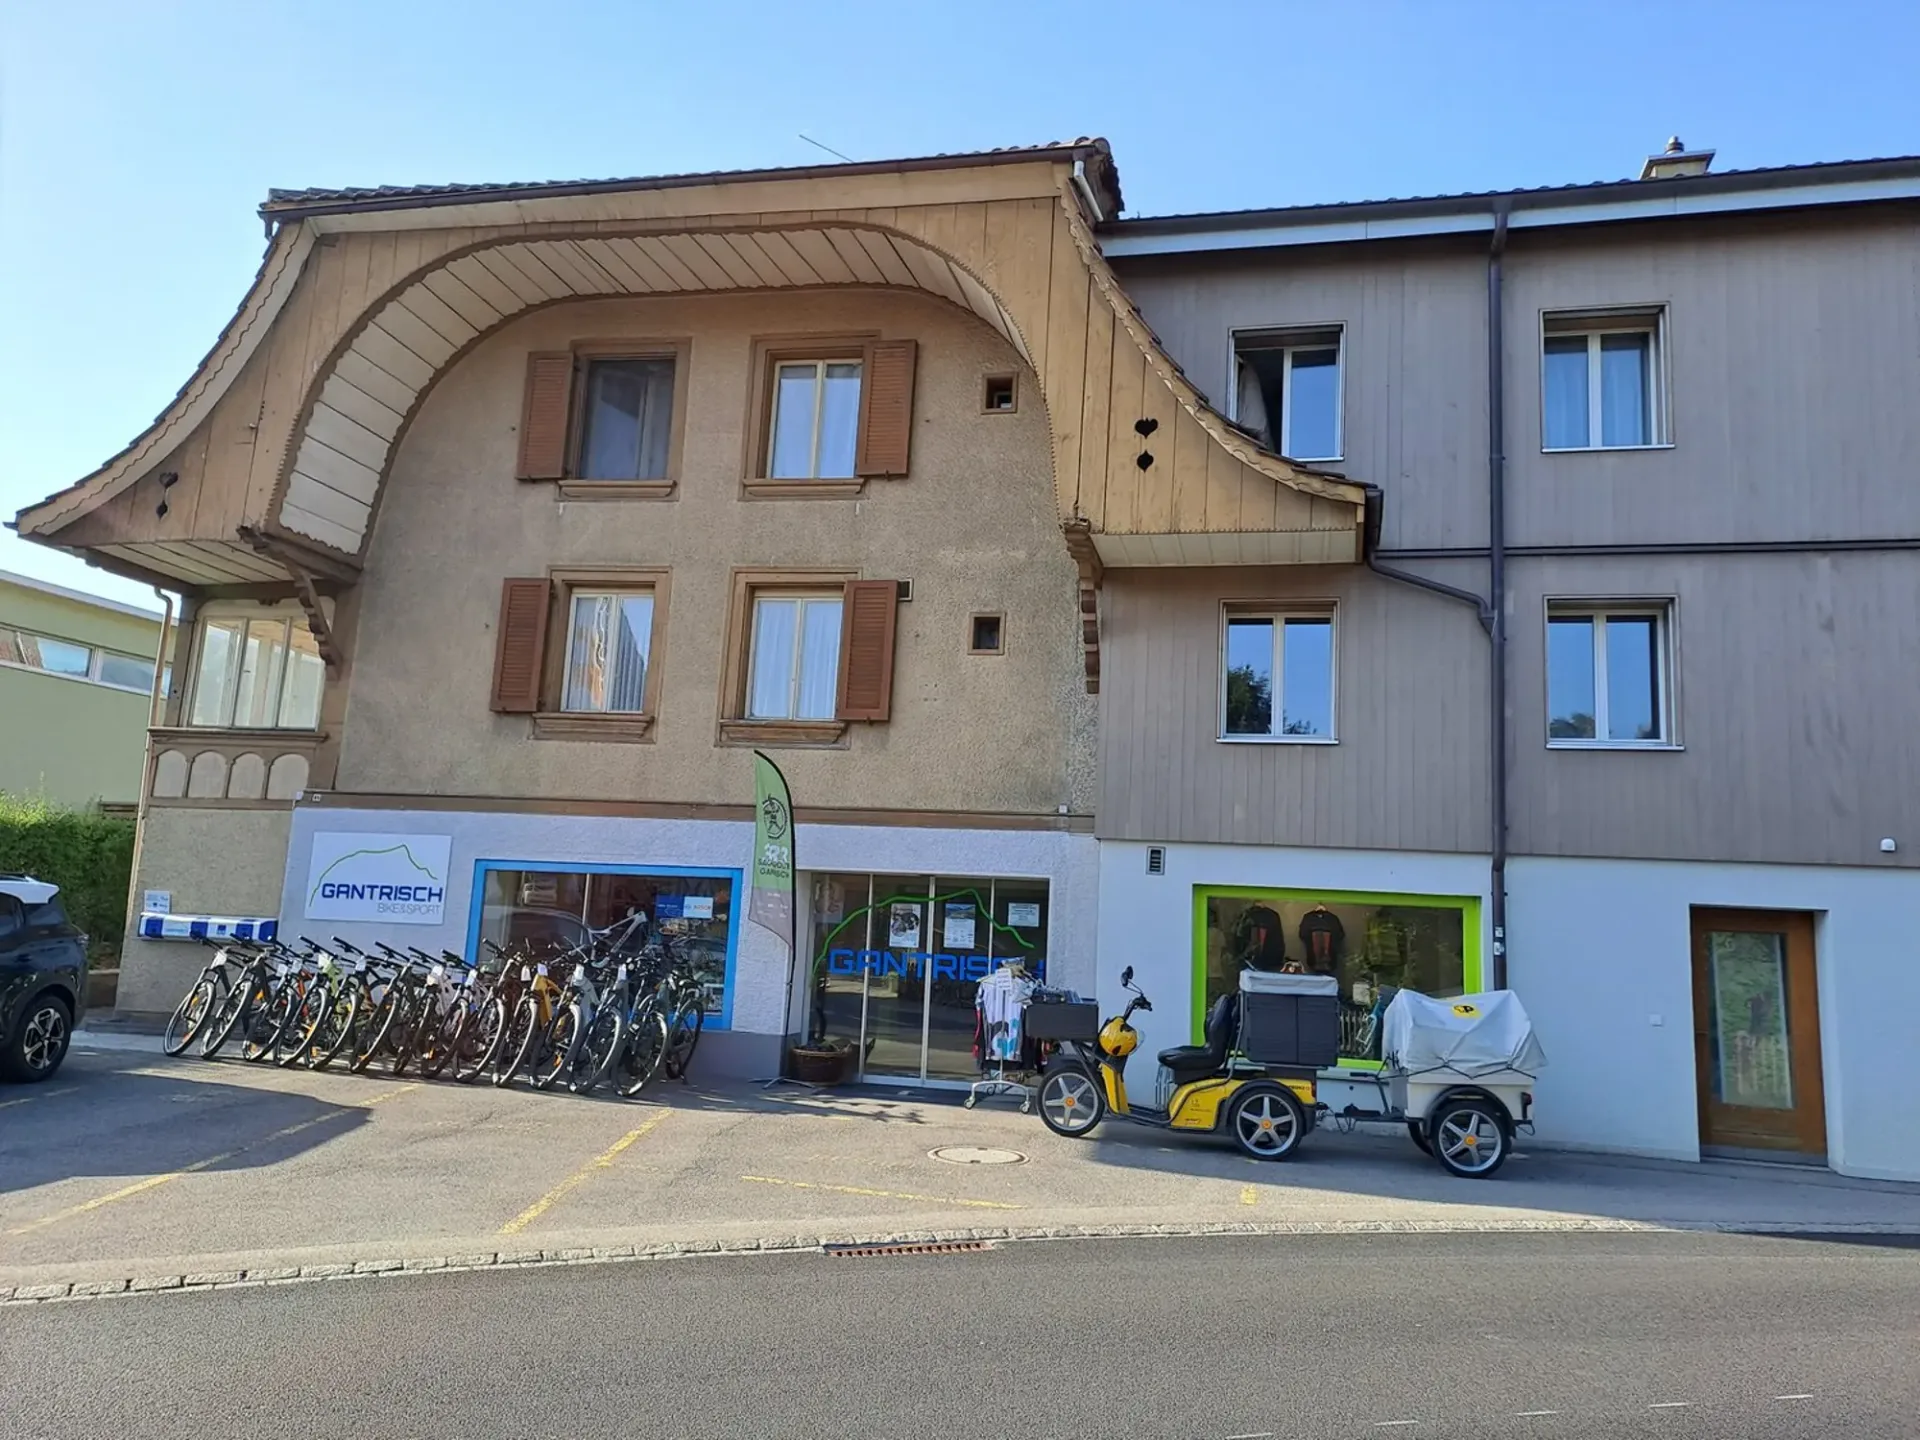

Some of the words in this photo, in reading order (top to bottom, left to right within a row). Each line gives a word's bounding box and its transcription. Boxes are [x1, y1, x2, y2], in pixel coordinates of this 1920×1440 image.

[321, 883, 444, 902] GANTRISCH
[377, 902, 440, 915] BIKE&SPORT
[828, 948, 1045, 982] GANTRIS
